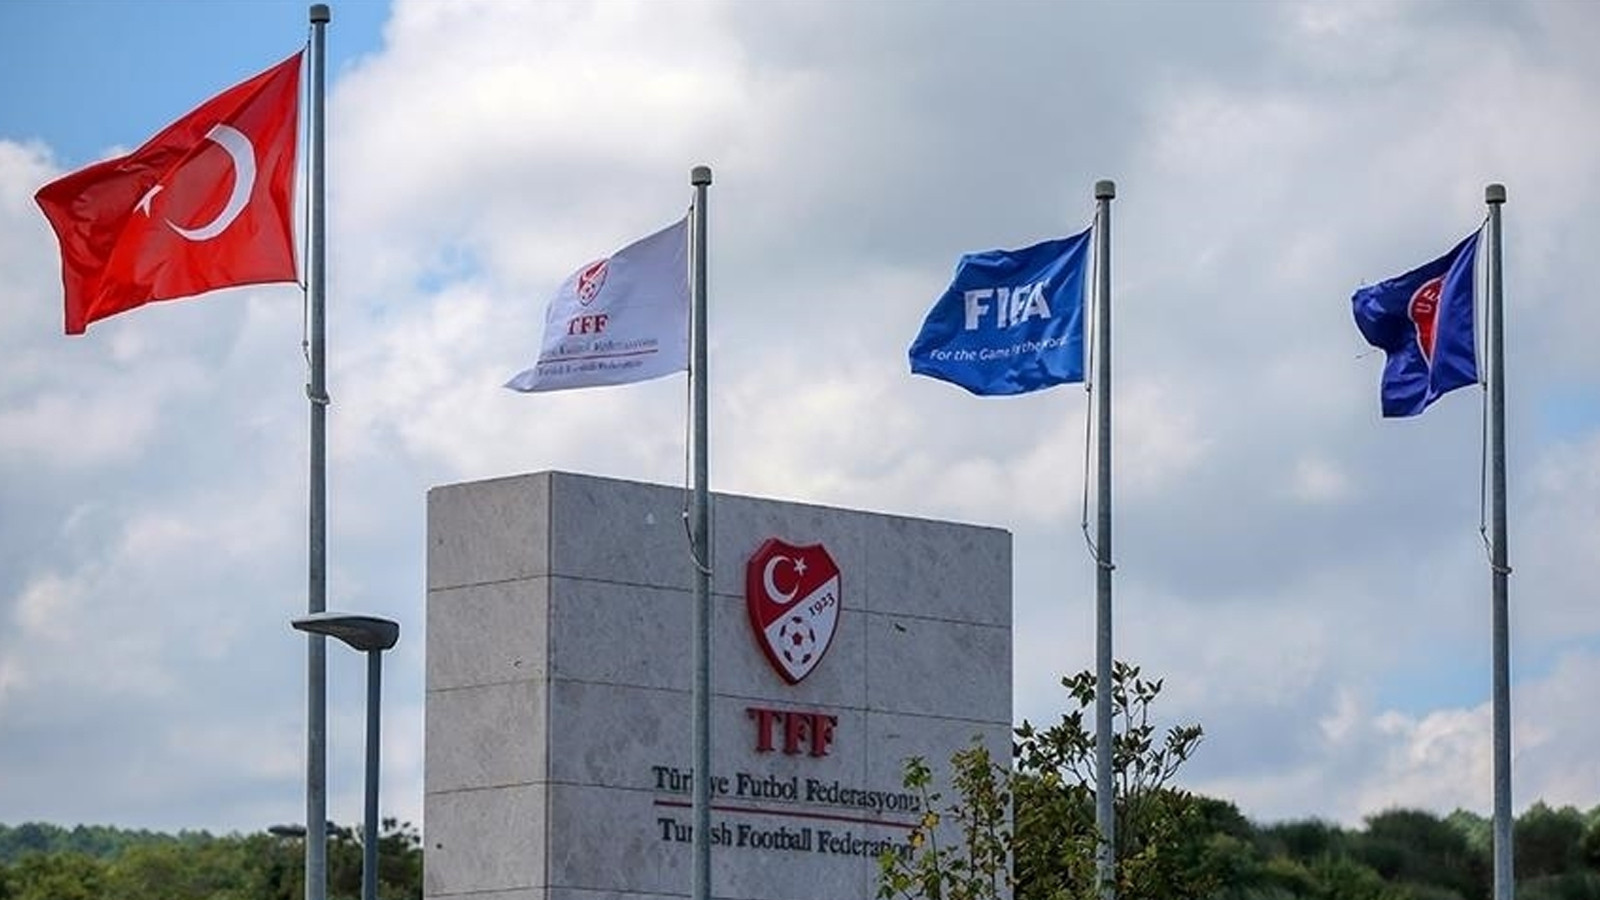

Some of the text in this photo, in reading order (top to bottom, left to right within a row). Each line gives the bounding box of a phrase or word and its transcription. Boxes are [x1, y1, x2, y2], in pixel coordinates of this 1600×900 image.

[964, 279, 1051, 331] FIFA
[566, 314, 608, 336] TFF
[929, 348, 953, 361] For
[953, 348, 978, 361] the
[808, 592, 836, 616] 1923
[746, 707, 838, 758] TFF
[651, 765, 920, 815] Türye Futbol Federasyonu
[657, 817, 732, 847] Tursh
[736, 823, 812, 851] Football
